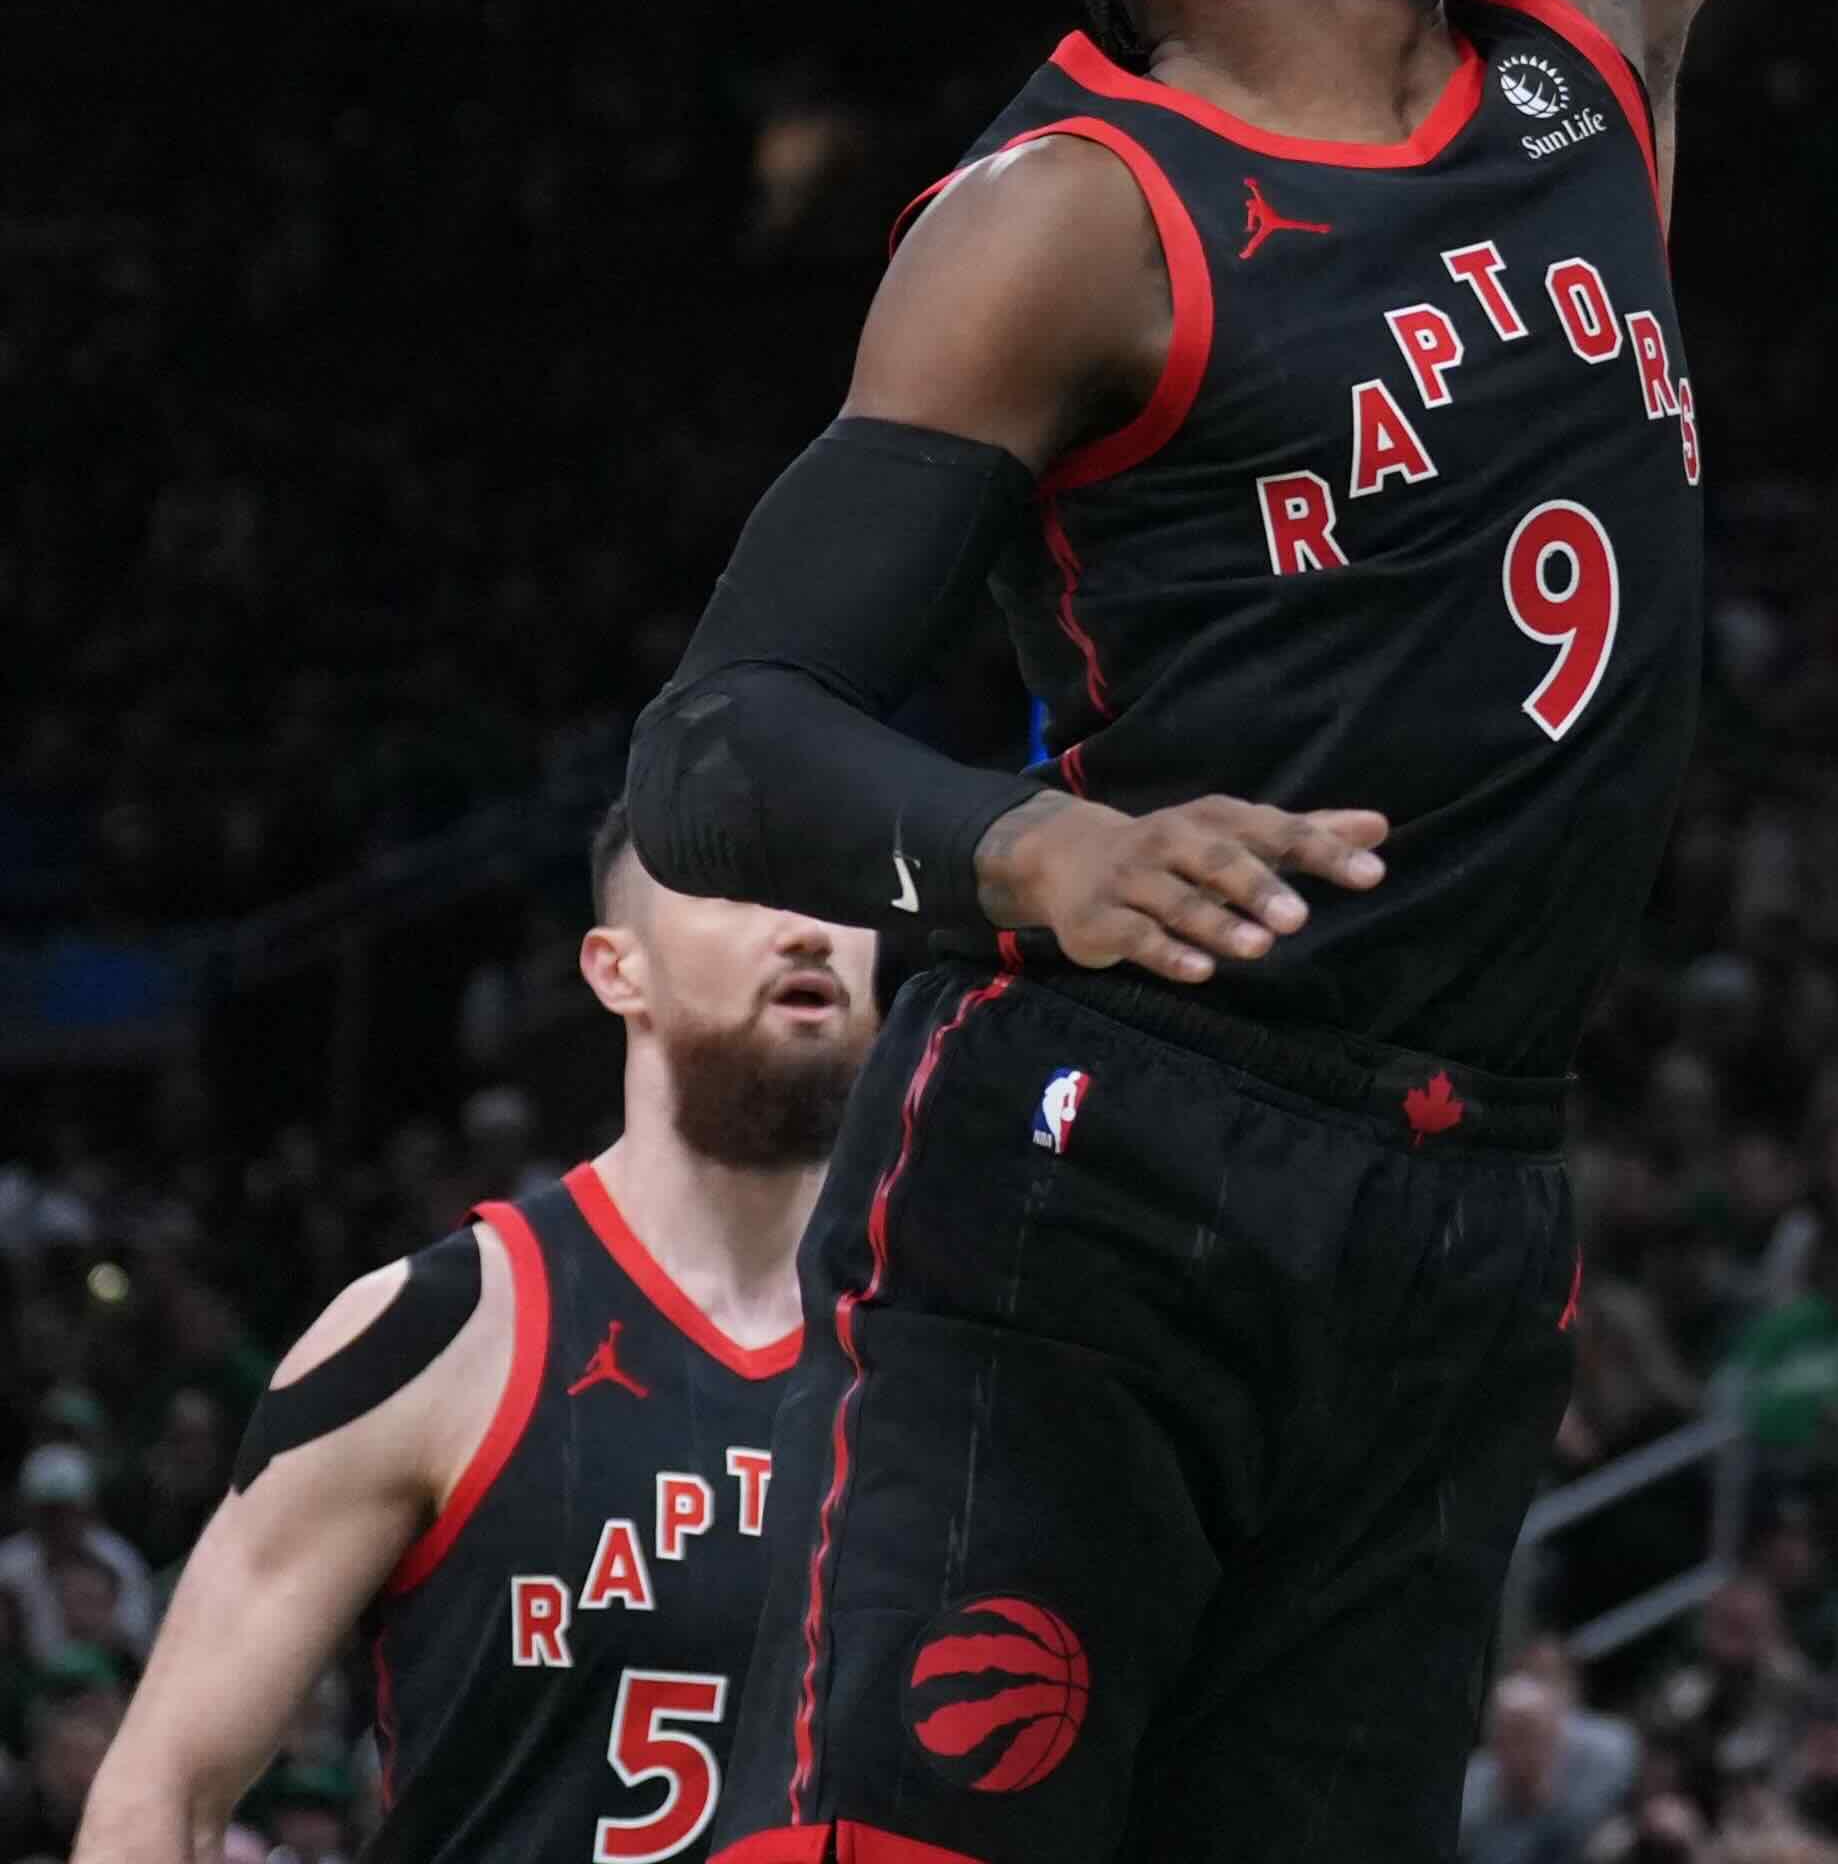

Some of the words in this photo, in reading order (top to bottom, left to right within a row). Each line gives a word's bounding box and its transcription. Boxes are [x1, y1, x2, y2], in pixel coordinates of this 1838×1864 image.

[1521, 130, 1569, 159] Sun
[1561, 107, 1608, 142] Life
[1256, 240, 1700, 576] RAPTORS
[1502, 498, 1620, 742] 9
[595, 1668, 729, 1864] 5
